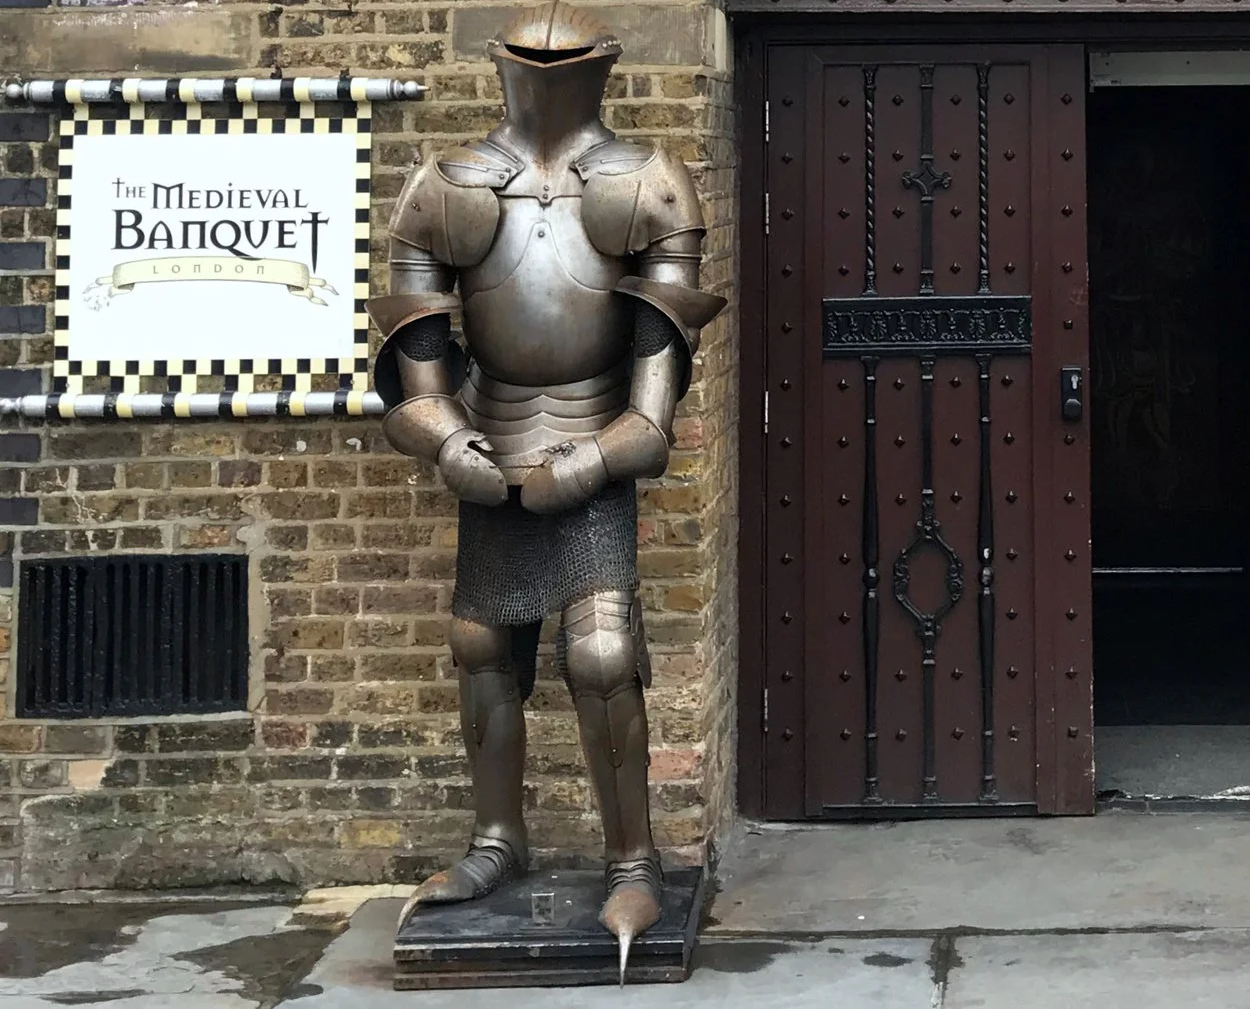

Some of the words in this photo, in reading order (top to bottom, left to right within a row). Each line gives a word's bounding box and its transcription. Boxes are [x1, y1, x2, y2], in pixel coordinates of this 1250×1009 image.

[112, 177, 147, 198] THE
[151, 182, 310, 209] MEDIEVAL
[111, 208, 330, 274] BANQUET
[153, 264, 265, 275] LONDON
